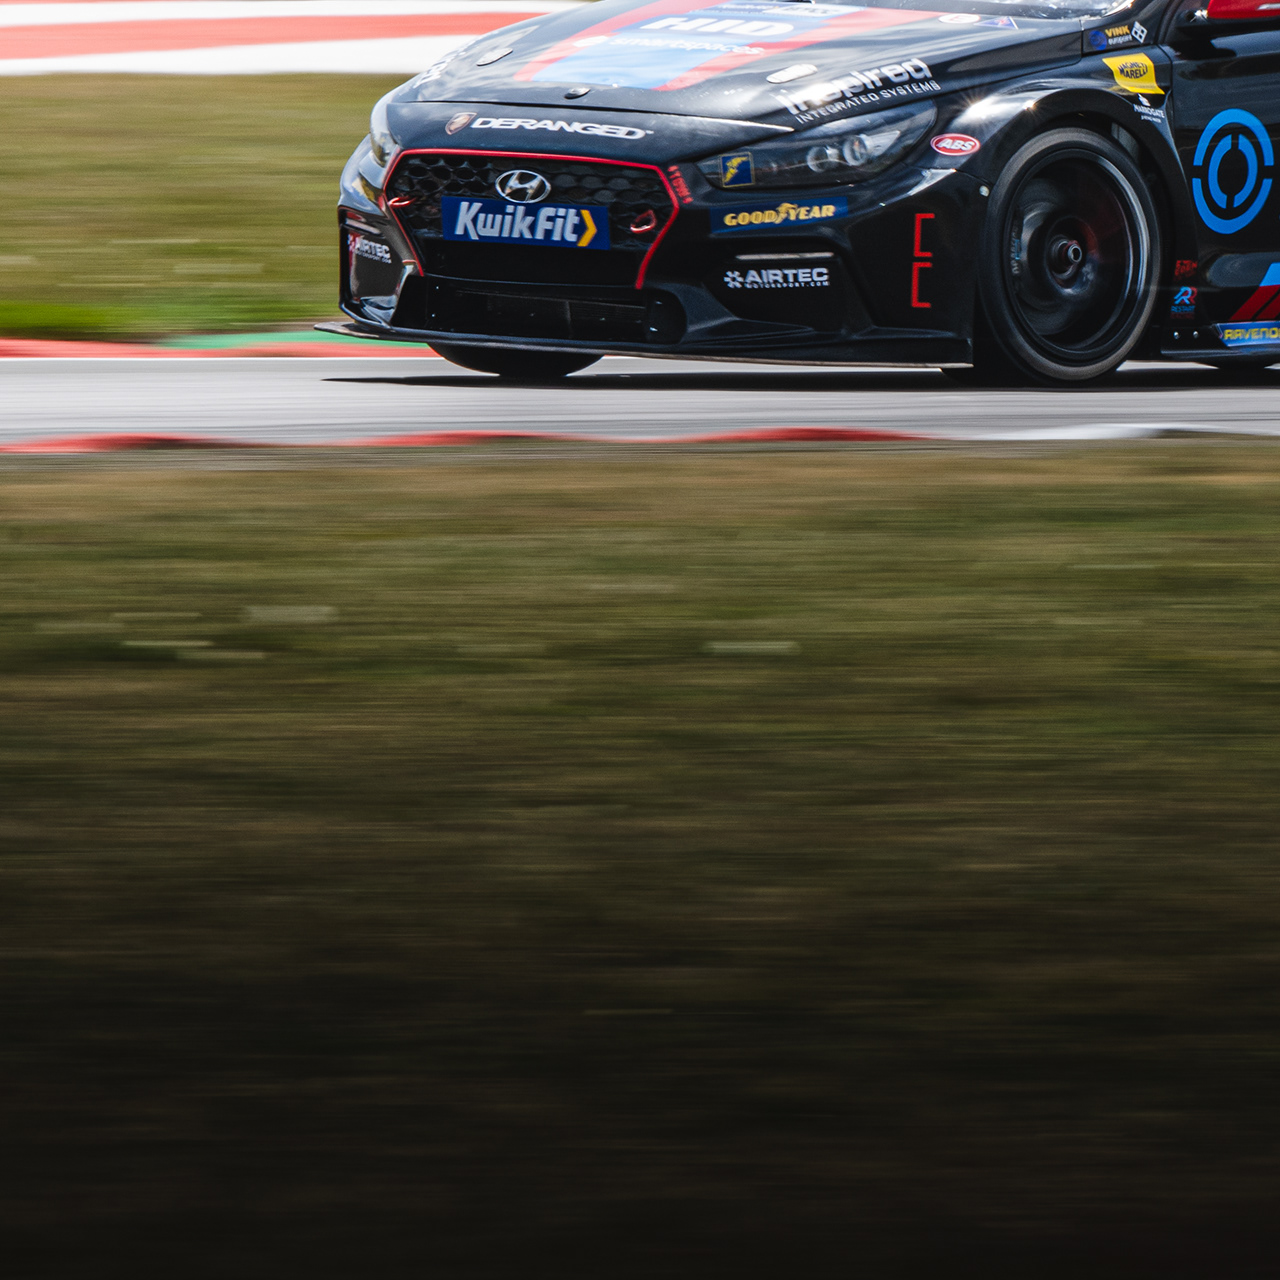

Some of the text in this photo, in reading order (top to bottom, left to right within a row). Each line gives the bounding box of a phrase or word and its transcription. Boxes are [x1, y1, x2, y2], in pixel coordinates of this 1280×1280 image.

[639, 17, 794, 37] HID
[1105, 25, 1131, 38] VINK
[795, 79, 942, 124] INTEGRATED SYSTEMS
[470, 117, 647, 140] DERANGED
[938, 137, 975, 151] ABS
[723, 204, 836, 226] GOODYEAR
[744, 267, 830, 283] AIRTEC
